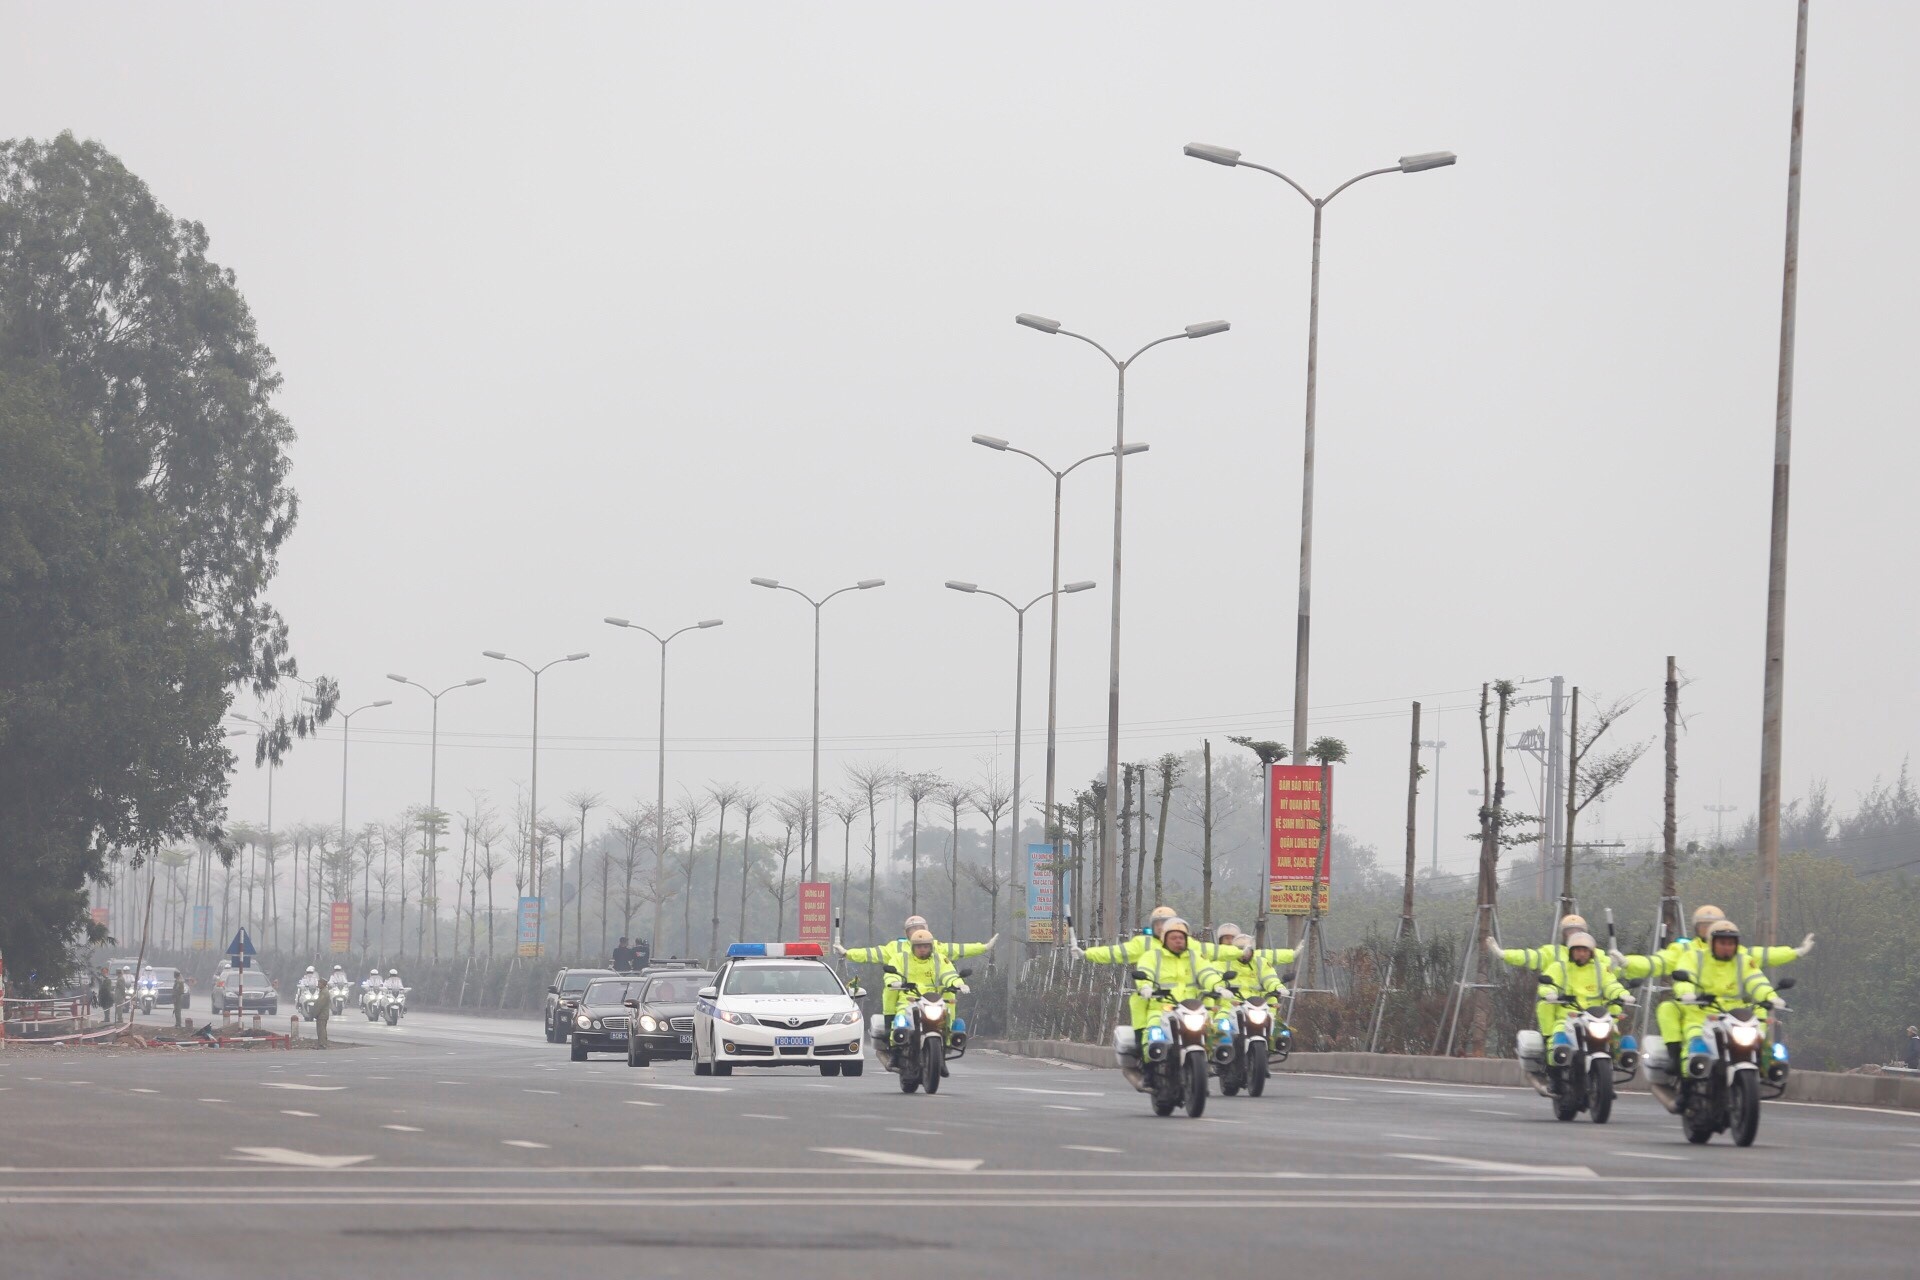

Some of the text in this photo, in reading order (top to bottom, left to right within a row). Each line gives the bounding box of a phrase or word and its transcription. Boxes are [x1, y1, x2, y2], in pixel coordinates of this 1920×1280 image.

[1289, 799, 1302, 811] QUAN
[1282, 818, 1295, 829] SINH
[1280, 836, 1293, 850] QUẬN
[1295, 838, 1307, 848] LONG
